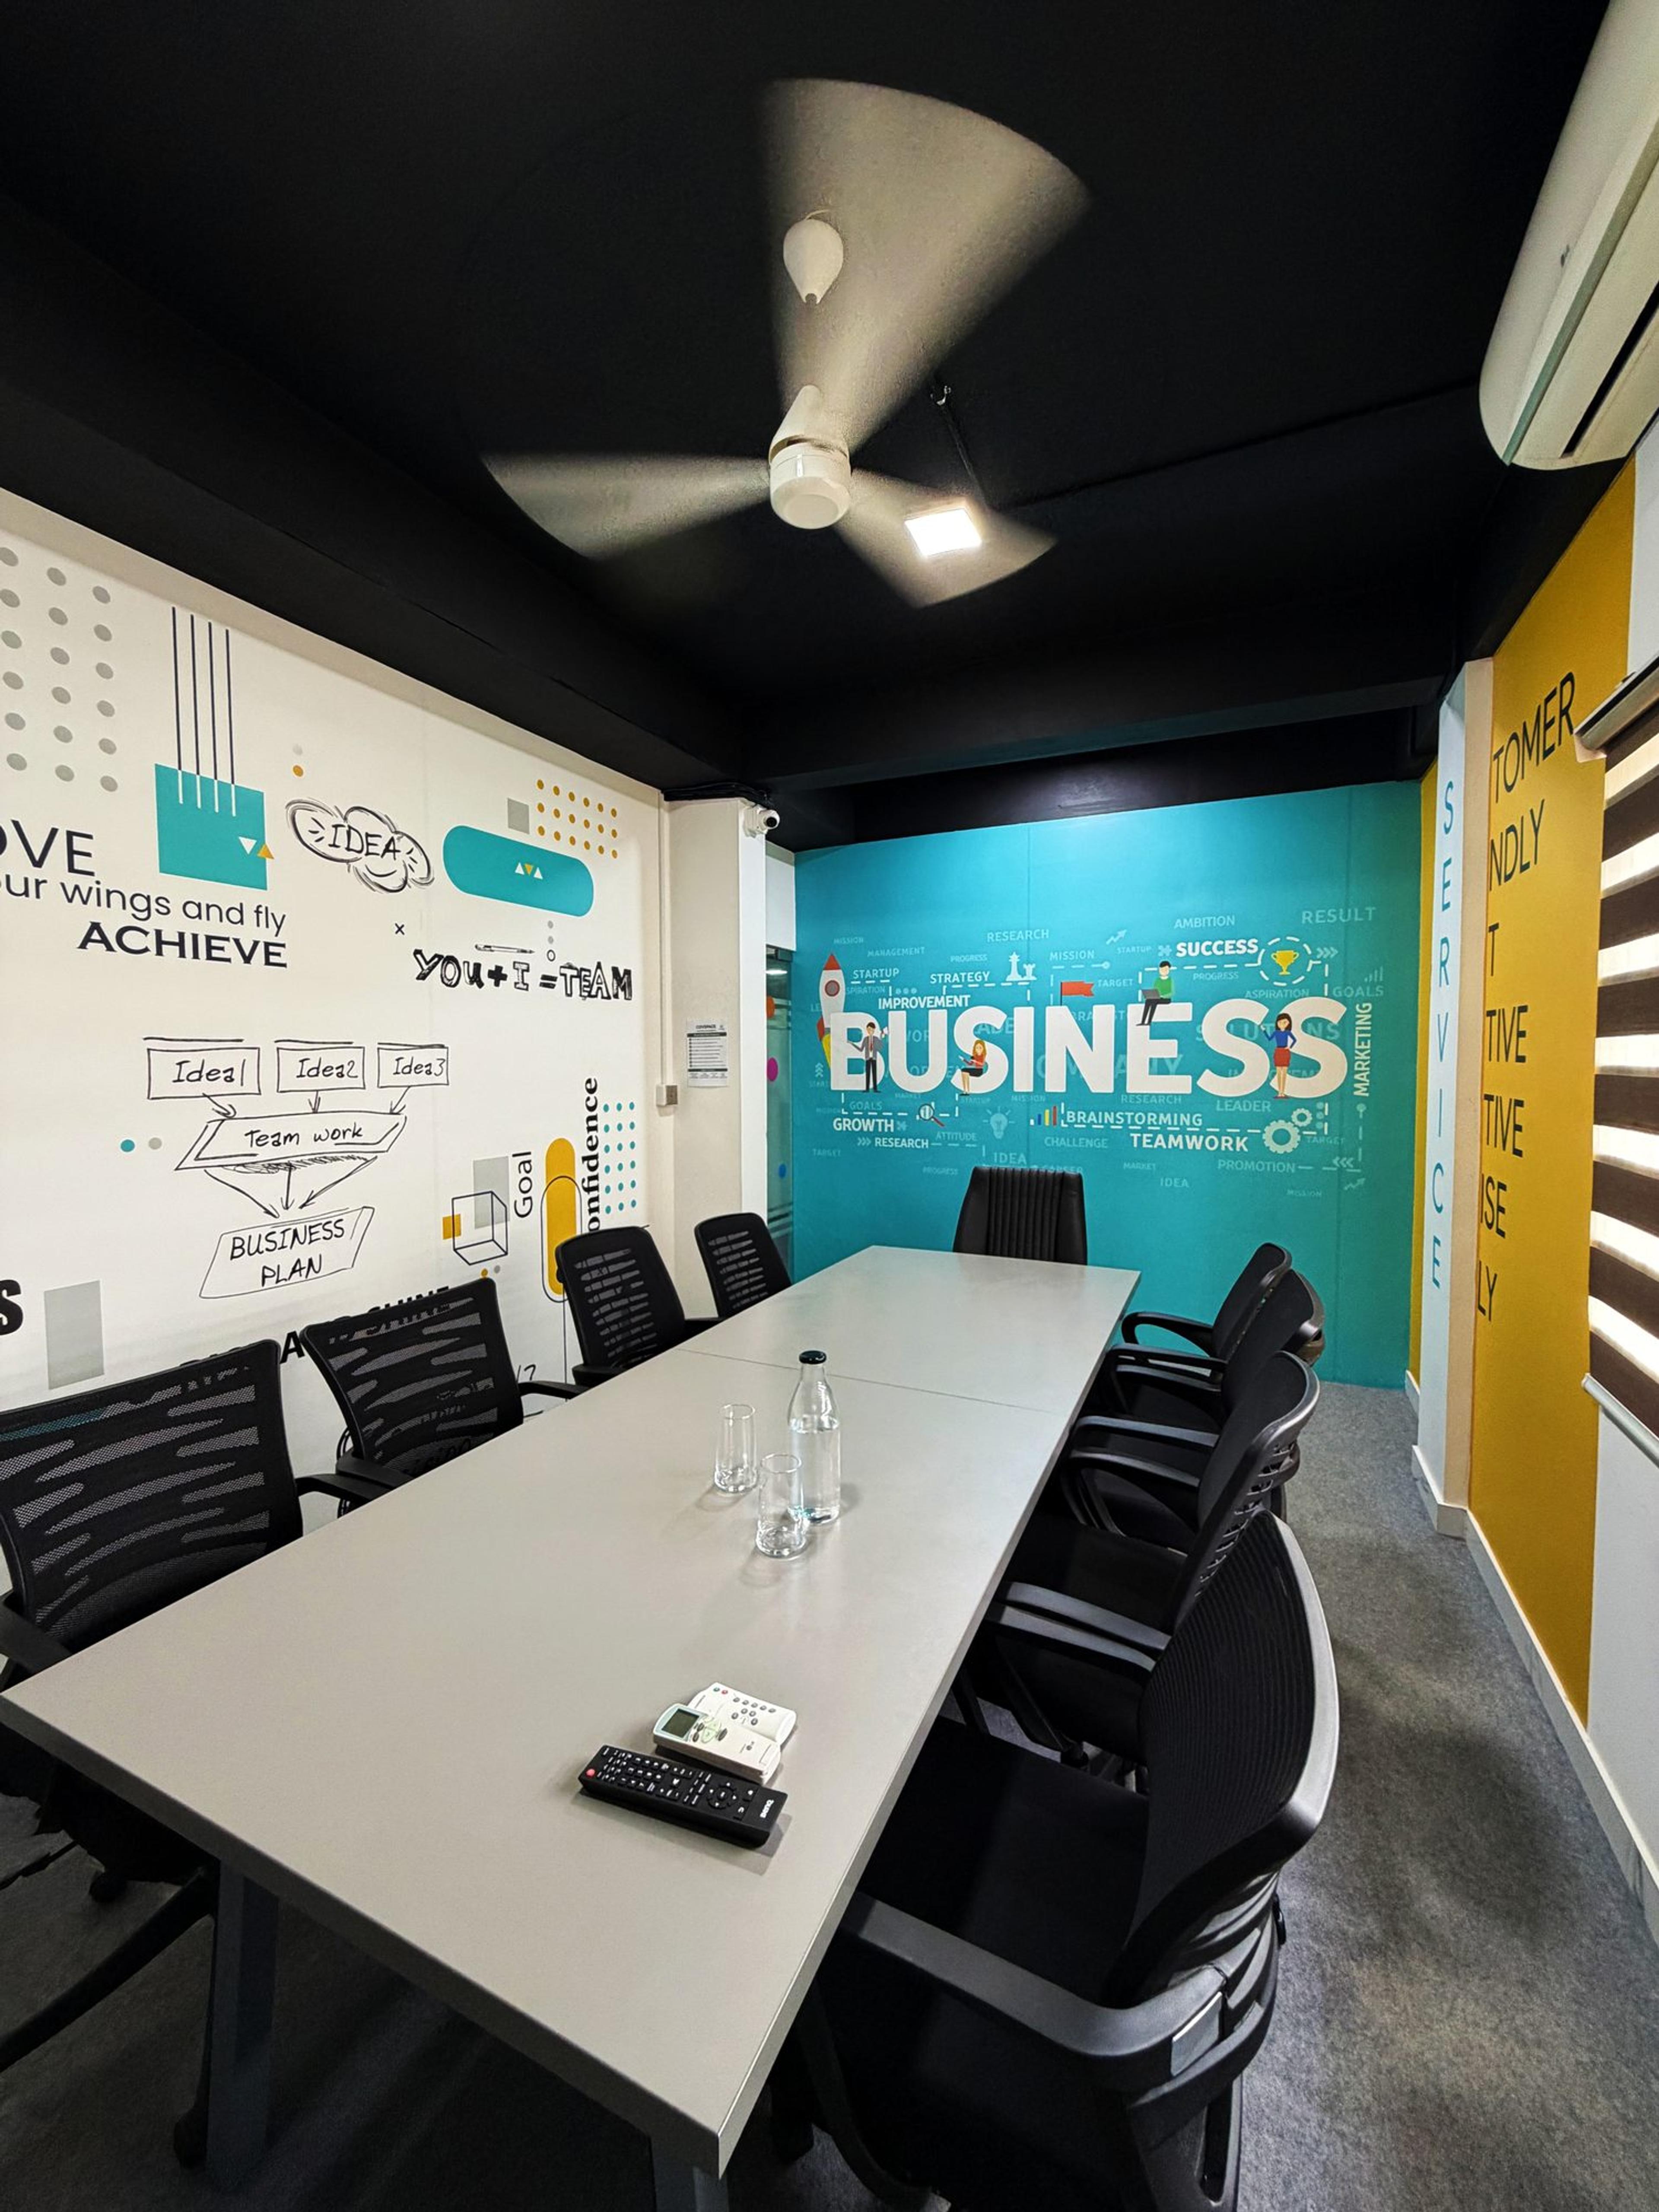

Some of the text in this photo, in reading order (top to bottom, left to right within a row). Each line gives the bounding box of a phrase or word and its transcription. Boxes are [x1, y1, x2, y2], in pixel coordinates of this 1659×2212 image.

[1493, 671, 1575, 804] TOMER
[0, 819, 95, 877] VE
[328, 823, 401, 859] IDEA
[1490, 799, 1545, 892] NDLY
[0, 874, 286, 937] ur wings and fly
[1174, 915, 1236, 929] AMBITION
[1302, 907, 1376, 924] RESULT
[987, 929, 1049, 942] RESEARCH
[77, 921, 287, 968] ACHIEVE
[867, 947, 925, 957] MANAGEMENT
[1176, 938, 1259, 957] SUCCESS
[950, 954, 988, 963] PROGRESS
[1049, 950, 1095, 961] MISSION
[853, 968, 899, 979] STARTUP
[930, 971, 990, 984] STRATEGY
[1193, 972, 1239, 981] PROGRESS
[1097, 979, 1133, 987] TARGET
[1245, 988, 1309, 999] ASPIRATION
[1333, 985, 1383, 998] GOALS
[878, 995, 970, 1010] IMPROVEMENT
[1486, 1005, 1528, 1063] TIVE
[830, 996, 1348, 1099] BUSINESS
[1354, 1002, 1372, 1097] MARKETING
[173, 1059, 246, 1087] Idea1
[296, 1058, 358, 1078] Idea2
[392, 1058, 444, 1076] Idea3
[849, 1101, 882, 1111] GOALS
[1121, 1095, 1182, 1104] RESEARCH
[1216, 1100, 1271, 1112] LEADER
[833, 1118, 894, 1132] GROWTH
[1066, 1111, 1203, 1126] BRAINSTORMING
[1484, 1093, 1525, 1158] TIVE
[245, 1122, 362, 1147] Team work
[935, 1131, 977, 1141] ATTITUDE
[874, 1138, 929, 1148] RESEARCH
[1044, 1136, 1108, 1149] CHALLENGE
[1130, 1133, 1249, 1152] TEAMWORK
[582, 1078, 600, 1231] onfidence
[994, 1152, 1027, 1165] IDEA
[1123, 1162, 1156, 1171] MARKET
[1217, 1159, 1296, 1173] PROMOTION
[512, 1152, 534, 1219] Goal
[1160, 1177, 1189, 1188] IDEA
[1481, 1173, 1507, 1239] ISE
[230, 1219, 345, 1260] BUSINESS
[261, 1254, 322, 1287] PLAN
